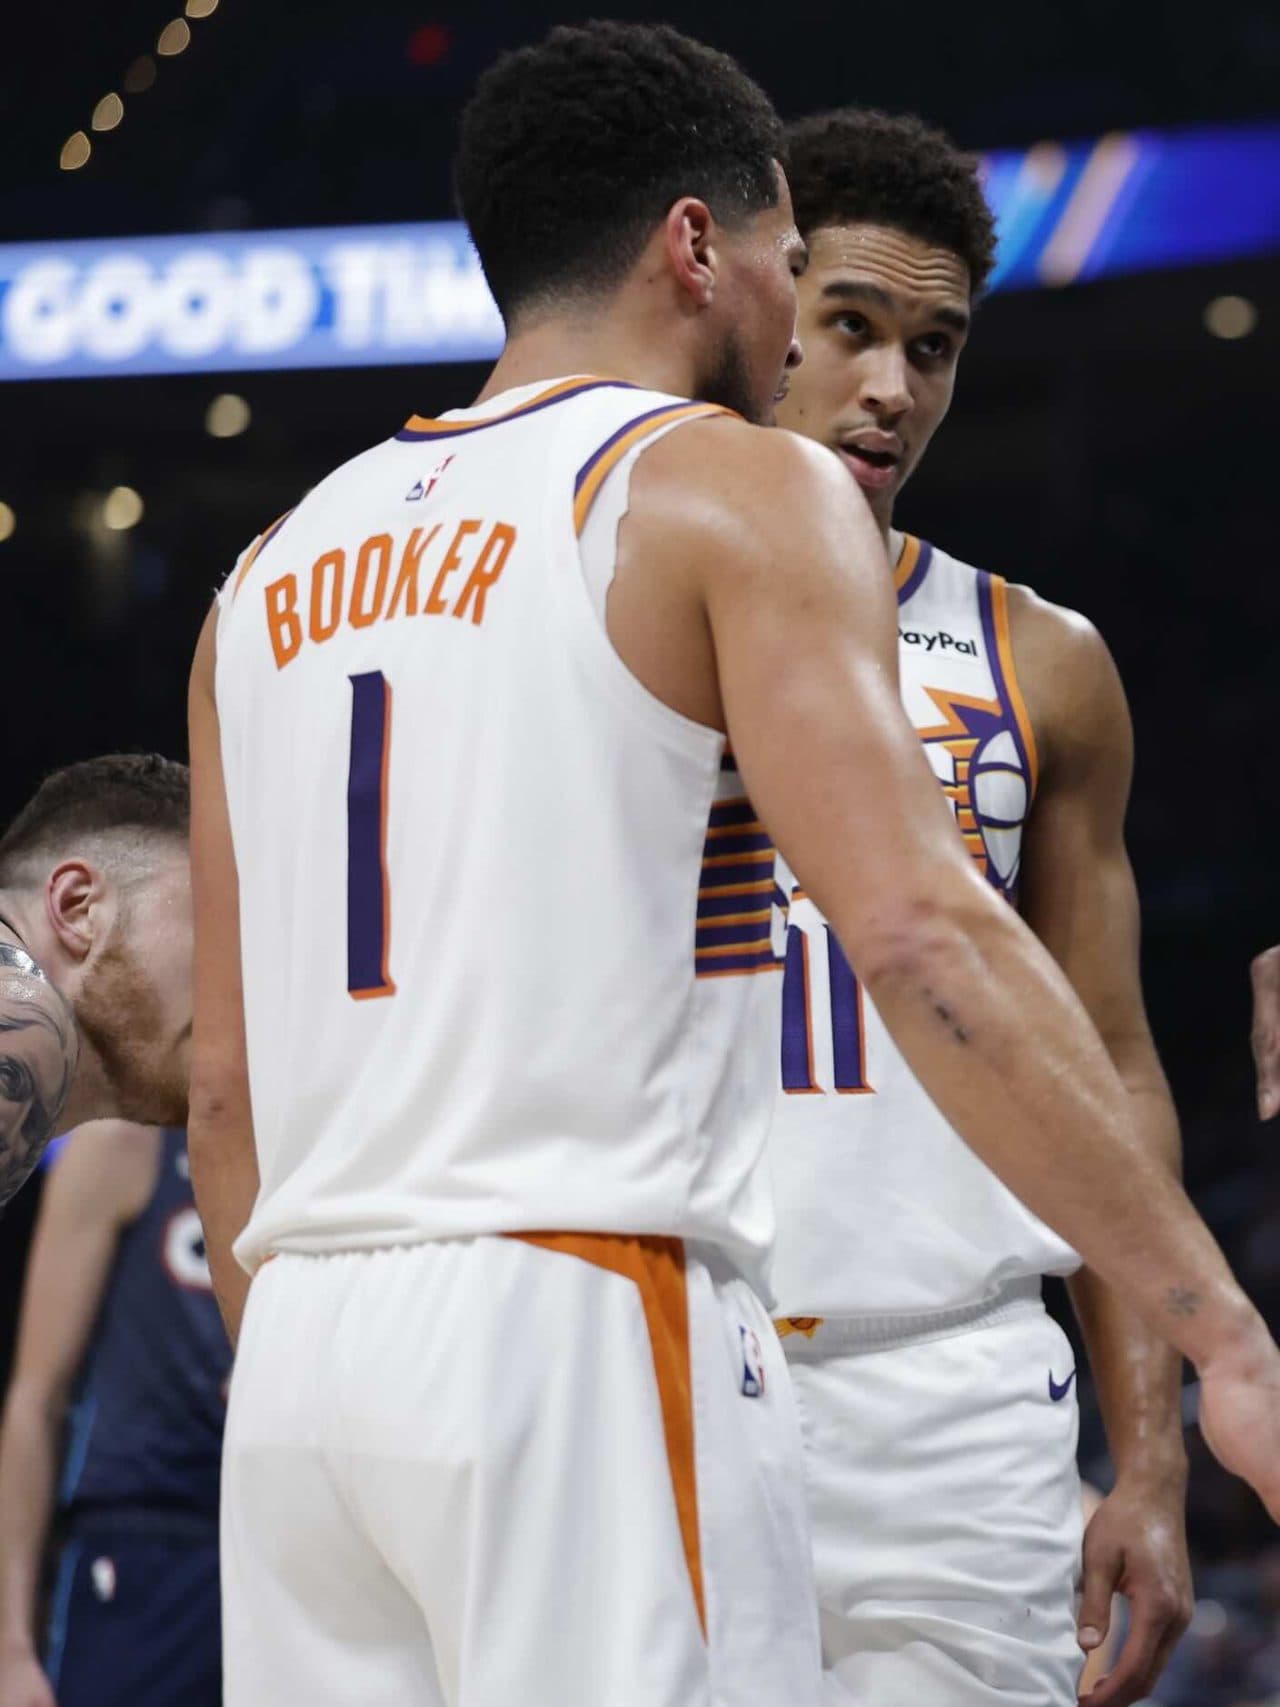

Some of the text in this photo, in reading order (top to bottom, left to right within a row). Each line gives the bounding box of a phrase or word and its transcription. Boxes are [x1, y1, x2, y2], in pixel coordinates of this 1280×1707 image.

[4, 246, 318, 366] GOOD
[264, 519, 518, 673] BOOKER
[897, 627, 977, 657] ayPal
[347, 669, 396, 1002] 1
[780, 923, 877, 1095] 11
